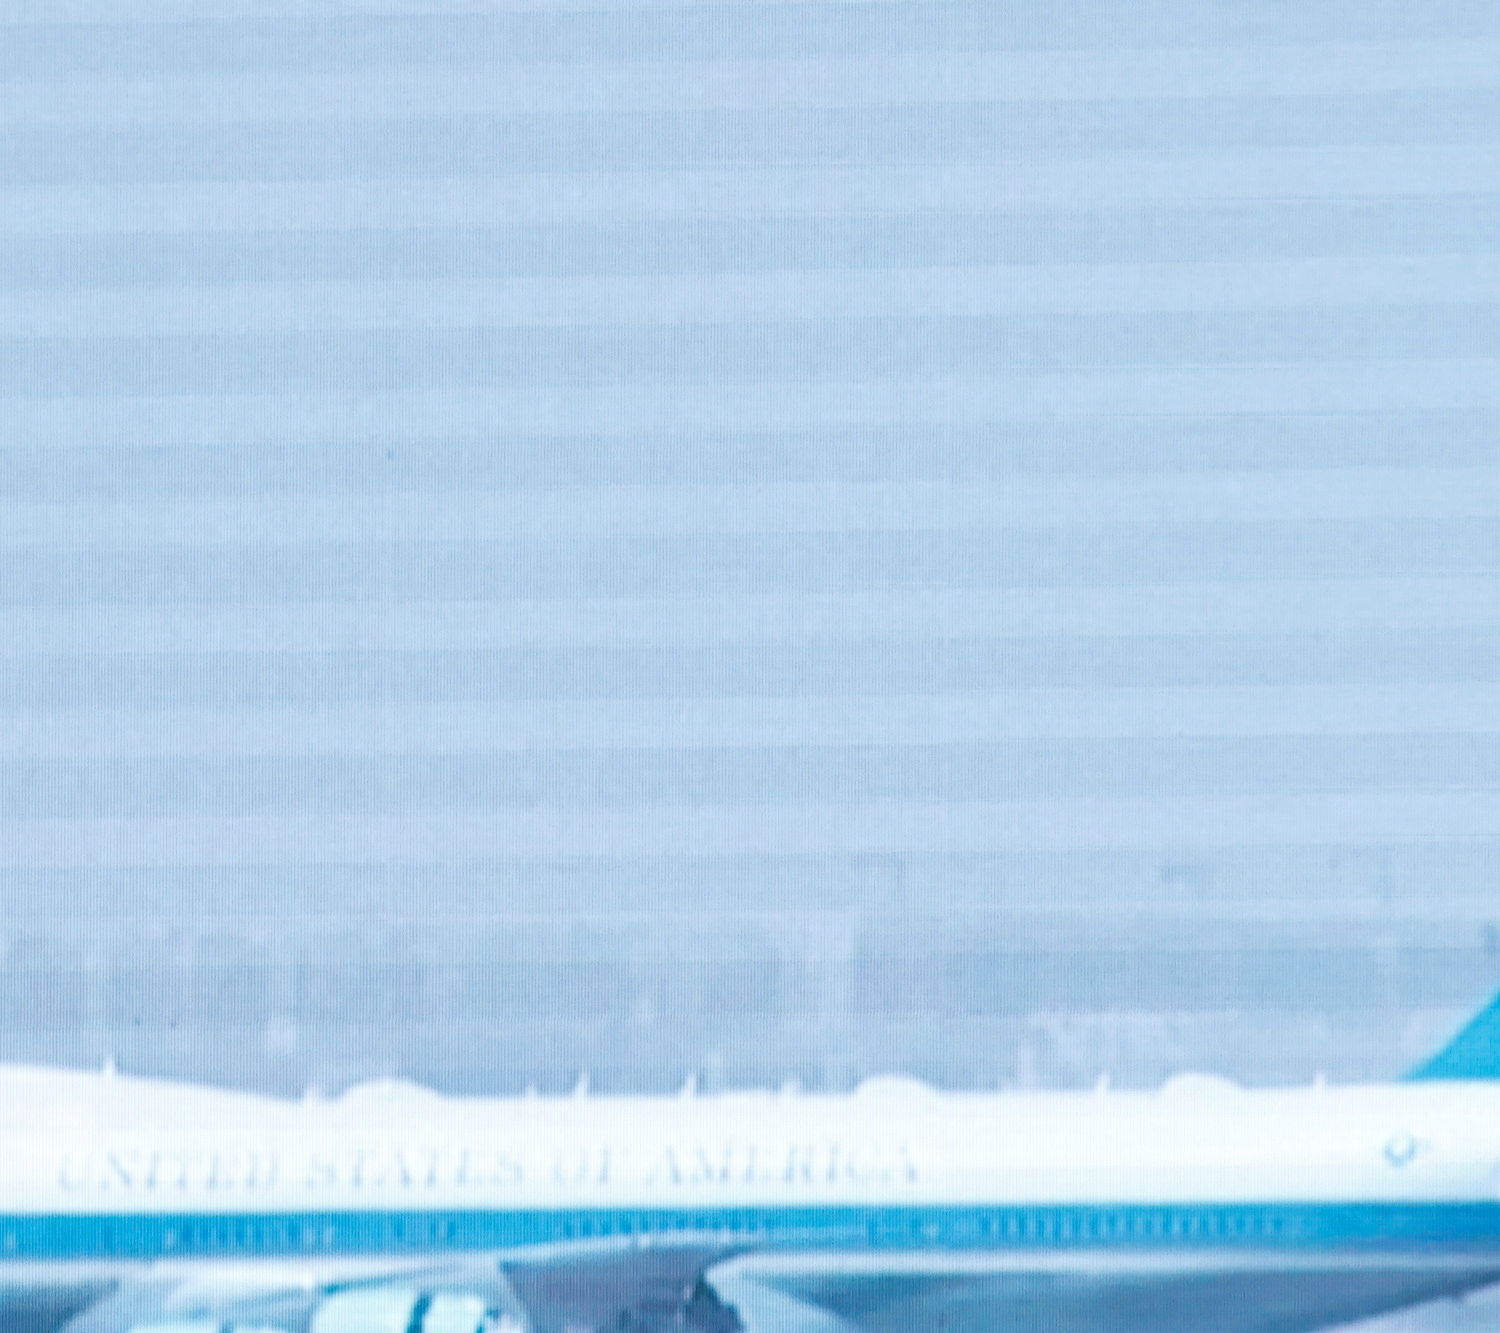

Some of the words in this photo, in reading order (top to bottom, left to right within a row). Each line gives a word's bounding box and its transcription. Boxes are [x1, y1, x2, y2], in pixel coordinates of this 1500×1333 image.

[54, 1150, 280, 1193] UNITED
[301, 1147, 526, 1192] STATES
[549, 1145, 630, 1190] OF
[644, 1142, 924, 1190] AMERICA
